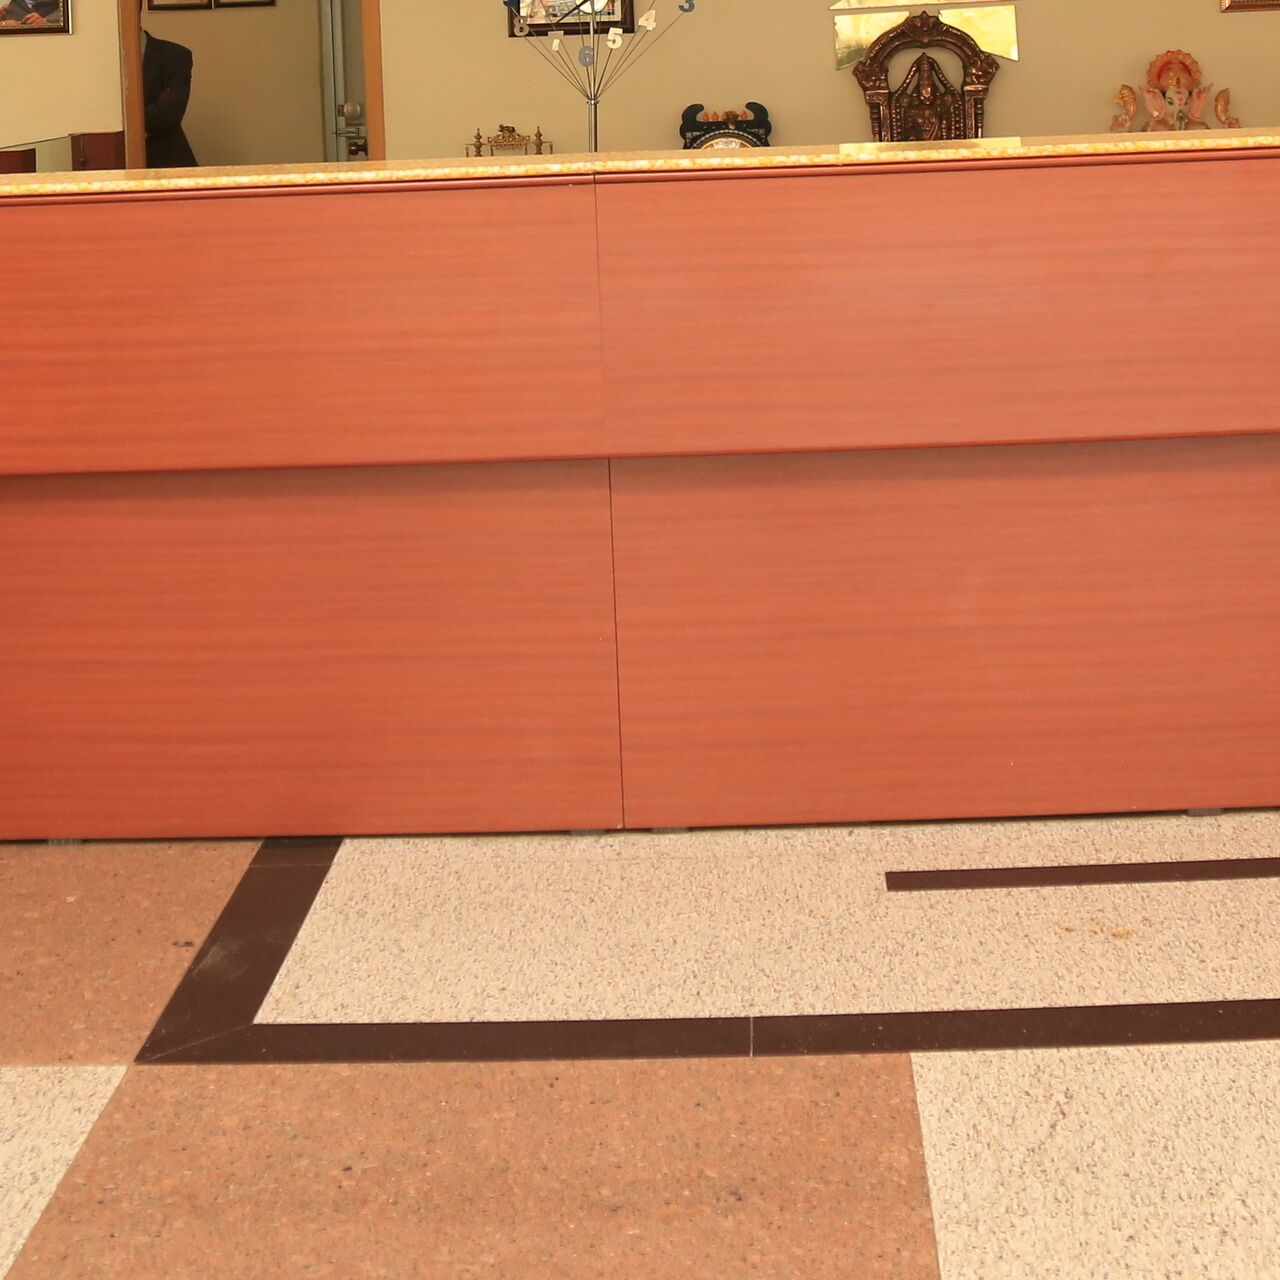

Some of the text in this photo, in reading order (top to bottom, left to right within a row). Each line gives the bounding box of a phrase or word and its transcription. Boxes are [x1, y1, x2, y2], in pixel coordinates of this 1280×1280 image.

[513, 15, 530, 37] 8
[638, 10, 657, 31] 4
[606, 27, 623, 49] 5
[578, 45, 594, 67] 6
